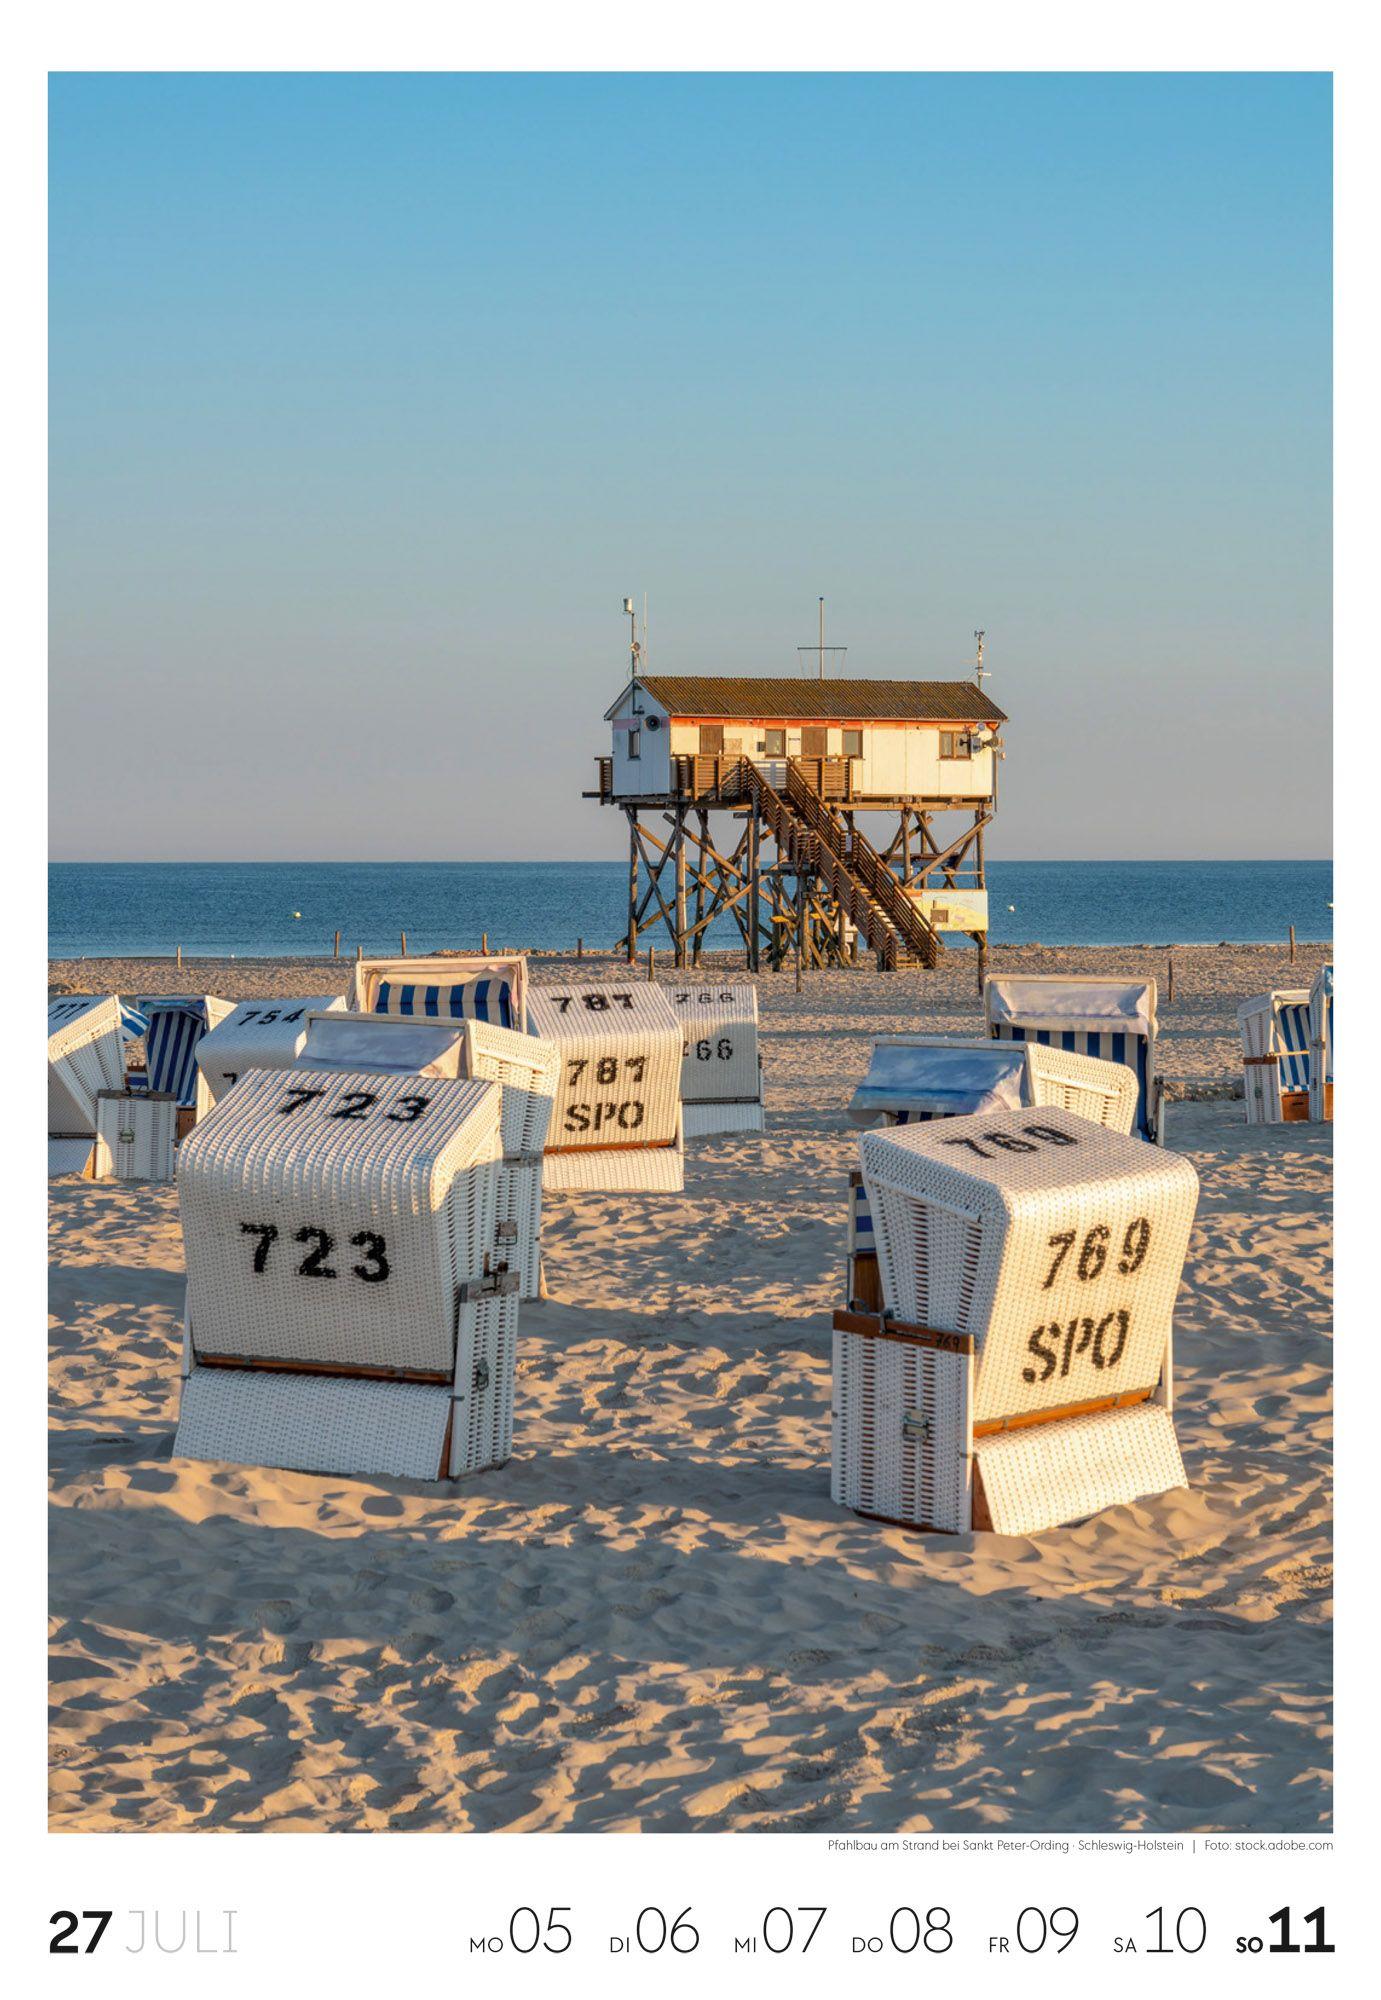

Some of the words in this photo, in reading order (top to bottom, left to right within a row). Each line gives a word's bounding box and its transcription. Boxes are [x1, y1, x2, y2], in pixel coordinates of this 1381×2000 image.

[550, 994, 633, 1013] 787
[675, 993, 734, 1004] 766
[238, 1008, 306, 1026] 754
[566, 1055, 649, 1086] 787
[279, 1089, 430, 1122] 723
[564, 1100, 645, 1132] SPO
[942, 1125, 1079, 1159] 769
[239, 1221, 392, 1283] 723
[1042, 1216, 1151, 1291] 769
[1021, 1309, 1130, 1383] SPO
